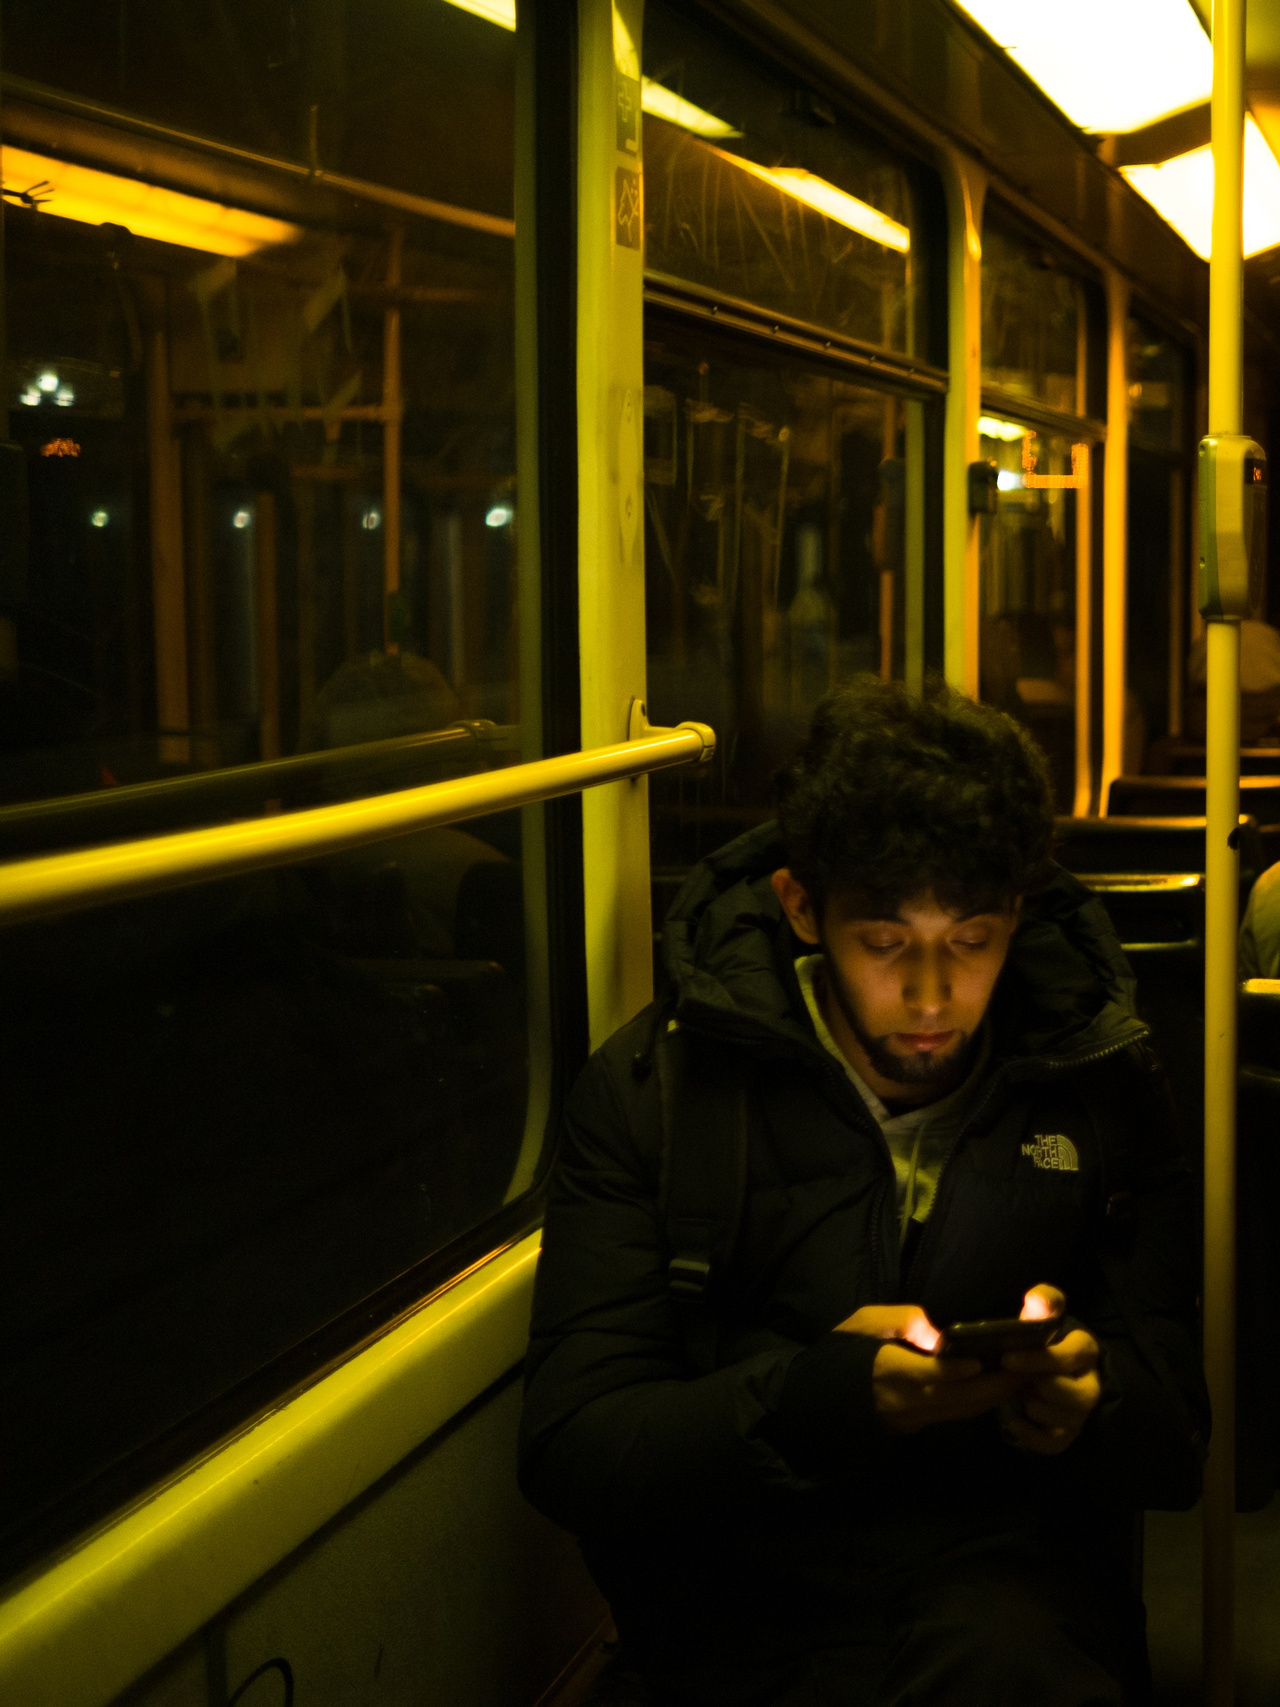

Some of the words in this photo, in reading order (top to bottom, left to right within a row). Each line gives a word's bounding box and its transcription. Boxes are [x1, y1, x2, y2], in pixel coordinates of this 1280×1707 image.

[1034, 1134, 1057, 1146] THE
[1021, 1143, 1057, 1158] NORTH
[1033, 1156, 1059, 1169] FACE
